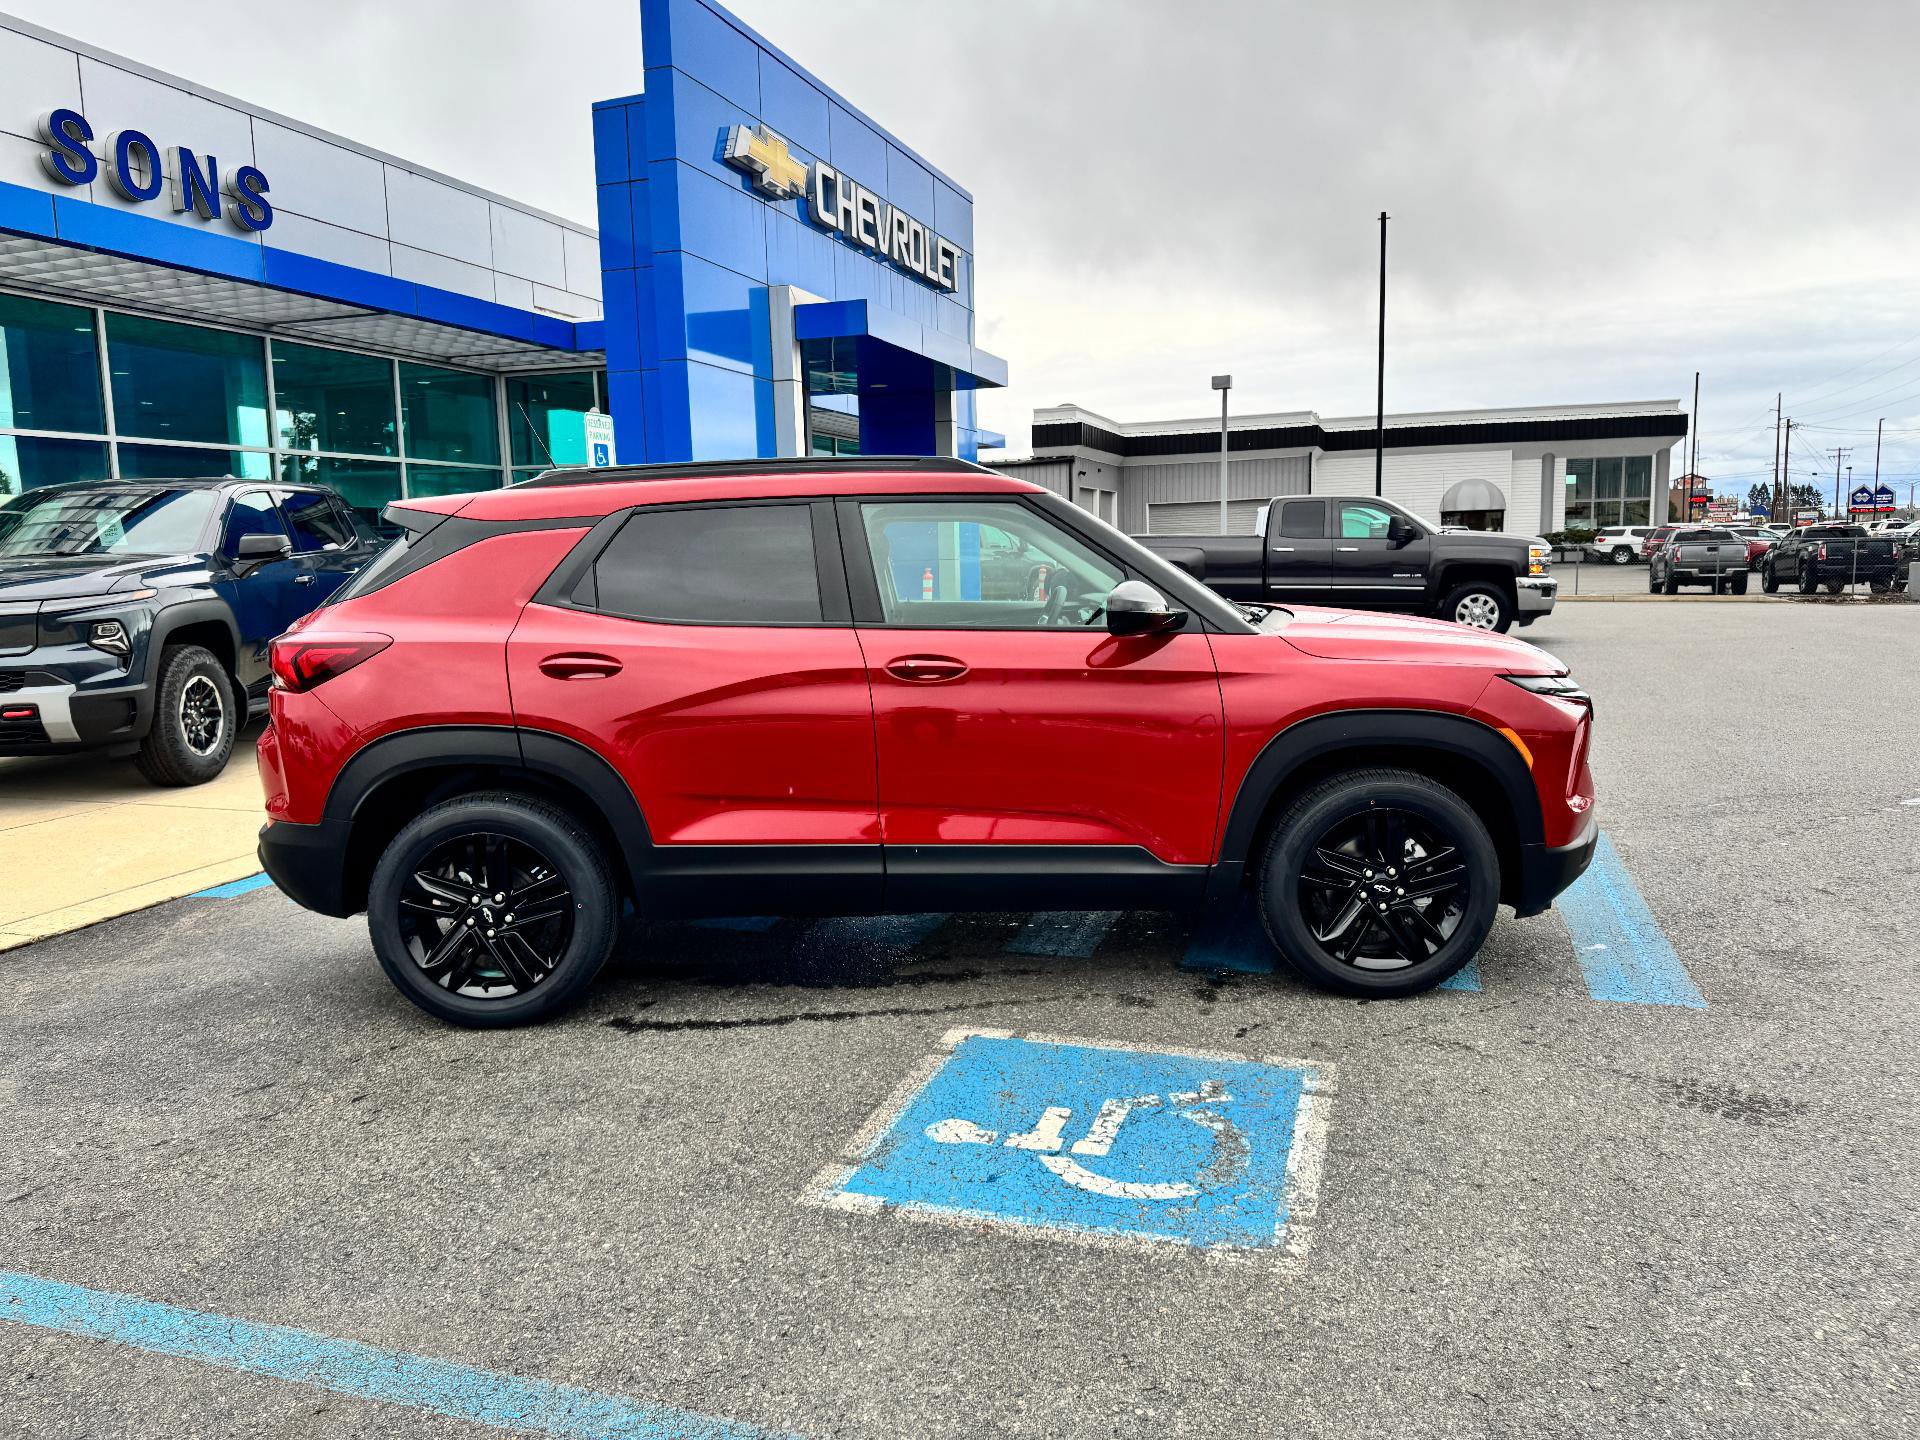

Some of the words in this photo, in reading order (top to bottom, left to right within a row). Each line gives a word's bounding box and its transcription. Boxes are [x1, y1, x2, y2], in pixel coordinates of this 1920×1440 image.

[42, 108, 273, 232] SONS
[810, 160, 962, 293] CHEVROLET
[588, 431, 611, 442] PARKING
